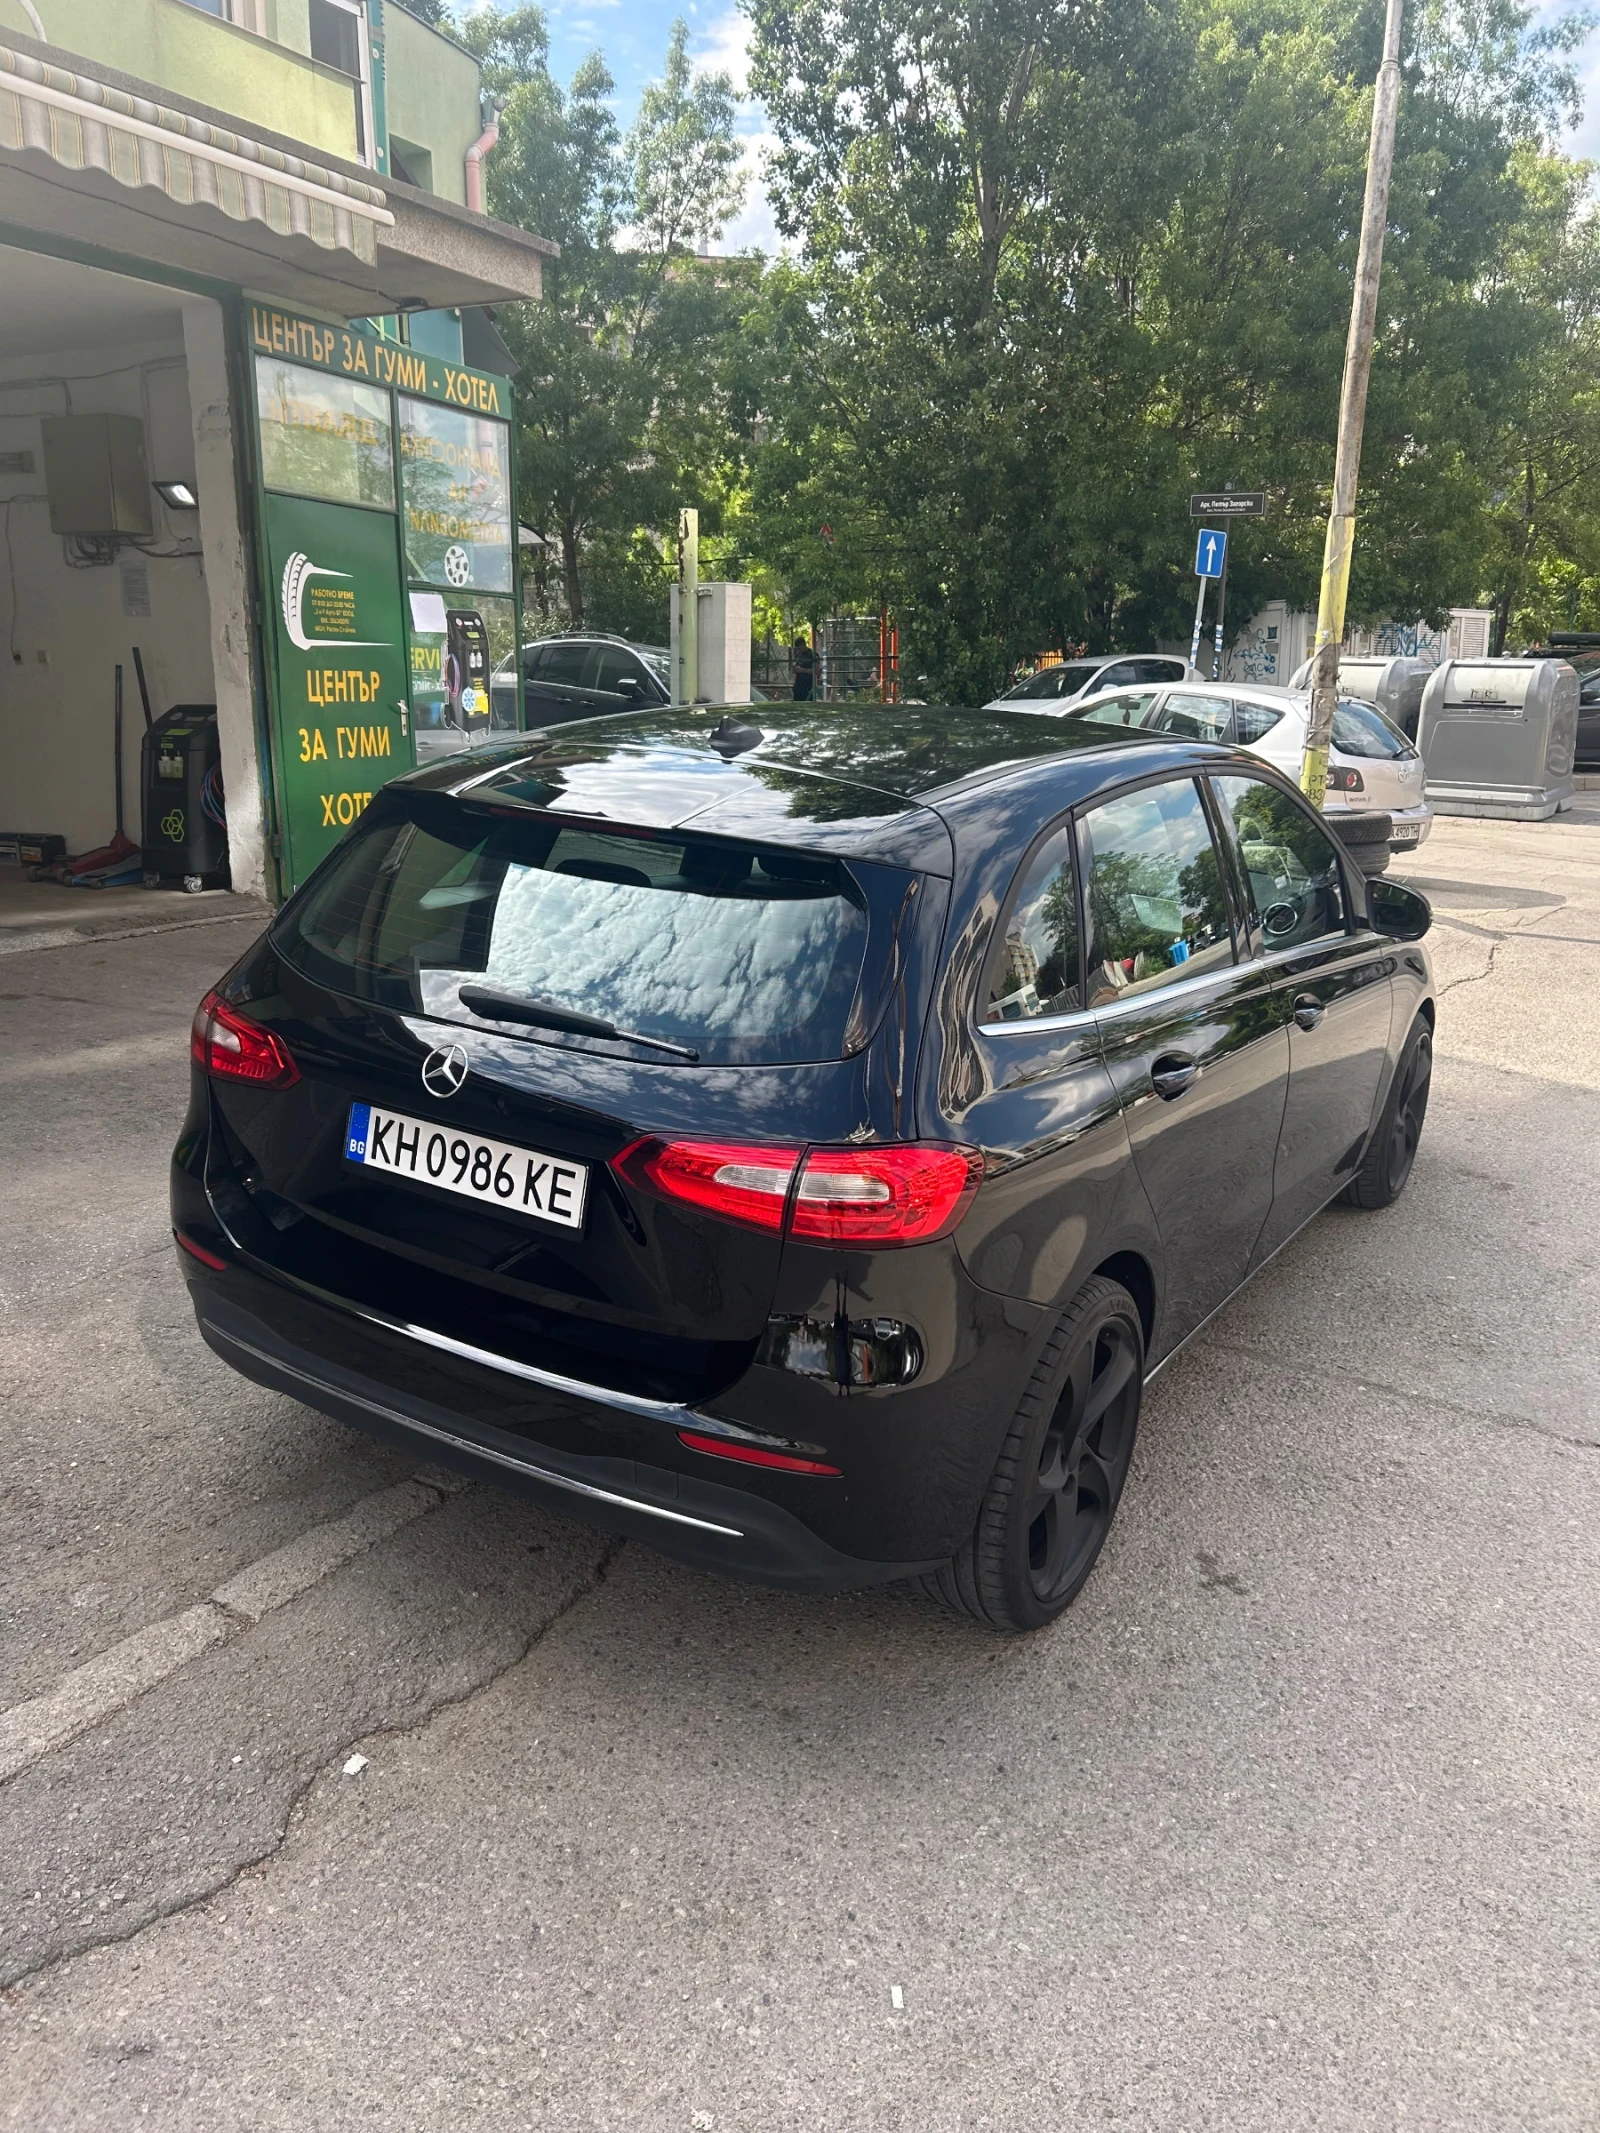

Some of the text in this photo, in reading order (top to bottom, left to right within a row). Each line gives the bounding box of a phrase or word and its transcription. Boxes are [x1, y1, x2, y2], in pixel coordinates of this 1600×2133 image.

[253, 308, 335, 364] ЦЕНТЪР
[342, 334, 369, 376] ЗА
[375, 345, 427, 393] ГУМИ
[444, 367, 500, 414] ХОТЕЛ
[311, 588, 355, 600] РАБОТНО ВРЕМЕ
[306, 670, 380, 707] ЦЕНТЪР
[298, 726, 391, 762] ЗА ГУМИ
[1396, 826, 1410, 838] 4920
[1410, 825, 1418, 837] TH
[350, 1116, 577, 1218] BG KH 0986 KE
